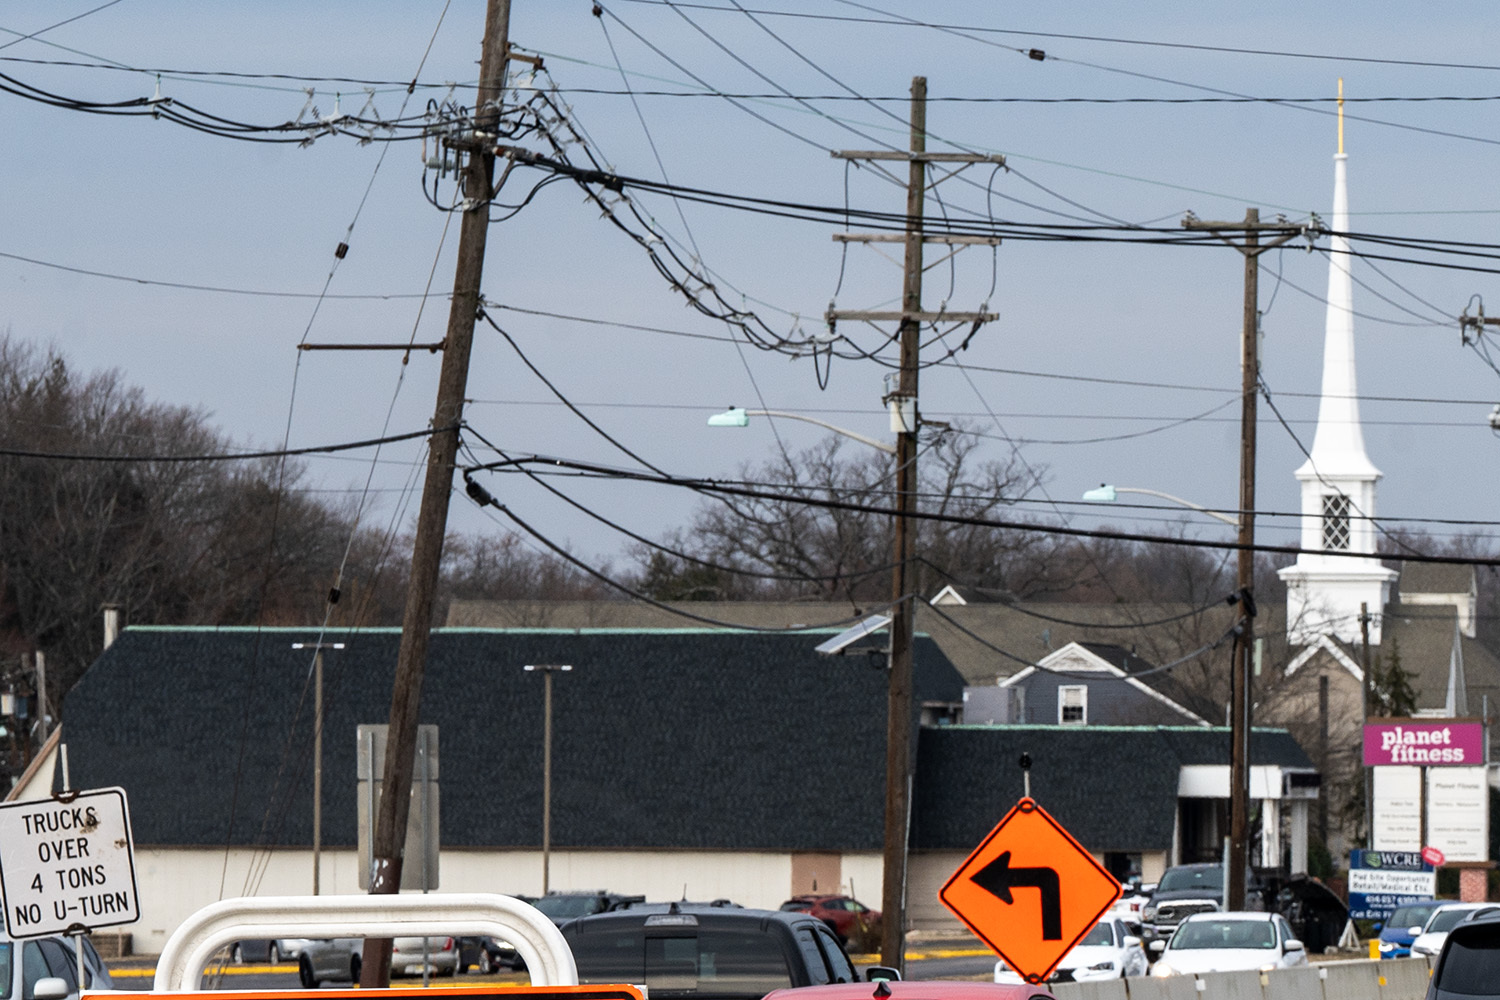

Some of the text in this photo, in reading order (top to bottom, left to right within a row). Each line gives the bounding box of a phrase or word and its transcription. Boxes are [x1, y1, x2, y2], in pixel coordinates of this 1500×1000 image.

[1381, 726, 1451, 750] planet
[1391, 744, 1465, 762] fitness
[22, 806, 98, 835] TRUCKS
[38, 837, 90, 862] OVER
[1381, 852, 1421, 866] WCRE
[31, 864, 106, 893] 4 TONS
[16, 891, 129, 926] NO U-TURN
